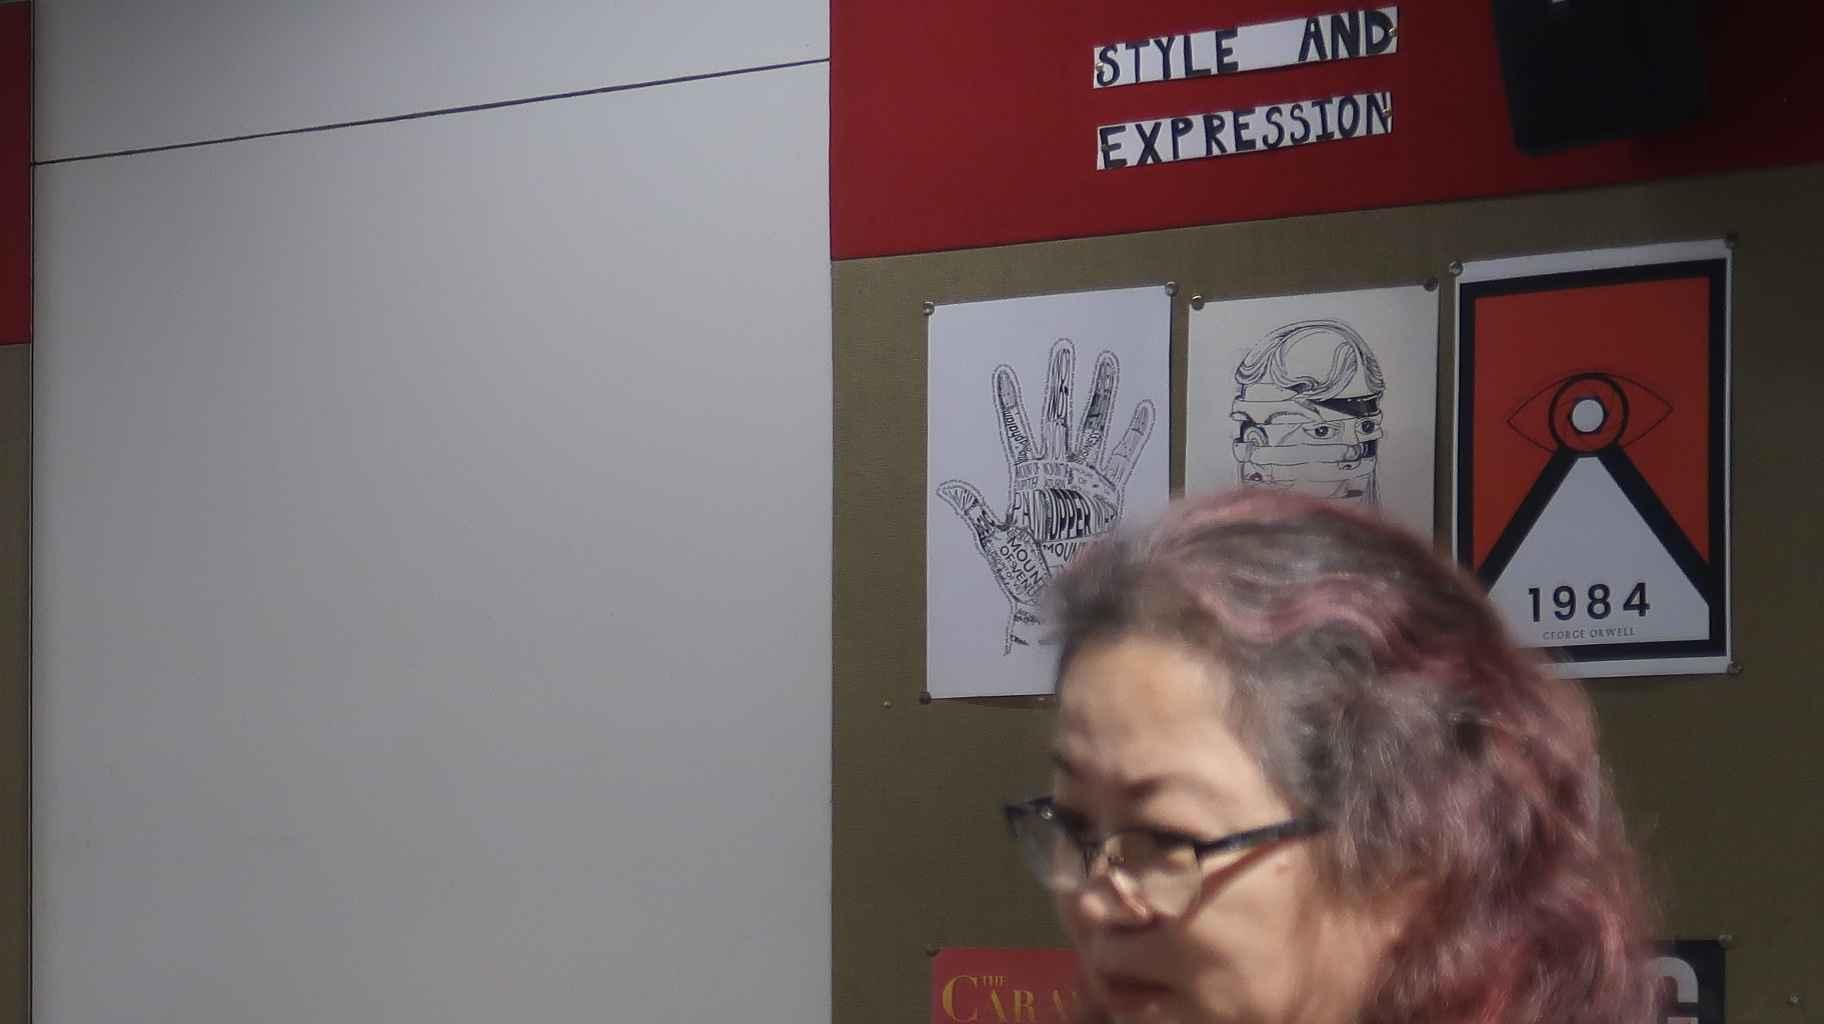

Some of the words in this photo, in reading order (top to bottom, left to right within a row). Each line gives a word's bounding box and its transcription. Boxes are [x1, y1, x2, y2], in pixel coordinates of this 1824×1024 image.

[1095, 28, 1239, 87] STYLE
[1298, 10, 1395, 62] AND
[1099, 94, 1390, 170] EXPRESSION
[1528, 582, 1651, 622] 1984
[1542, 629, 1586, 641] GEORGE
[1589, 627, 1636, 639] ORWELL
[942, 974, 1078, 1024] CARA
